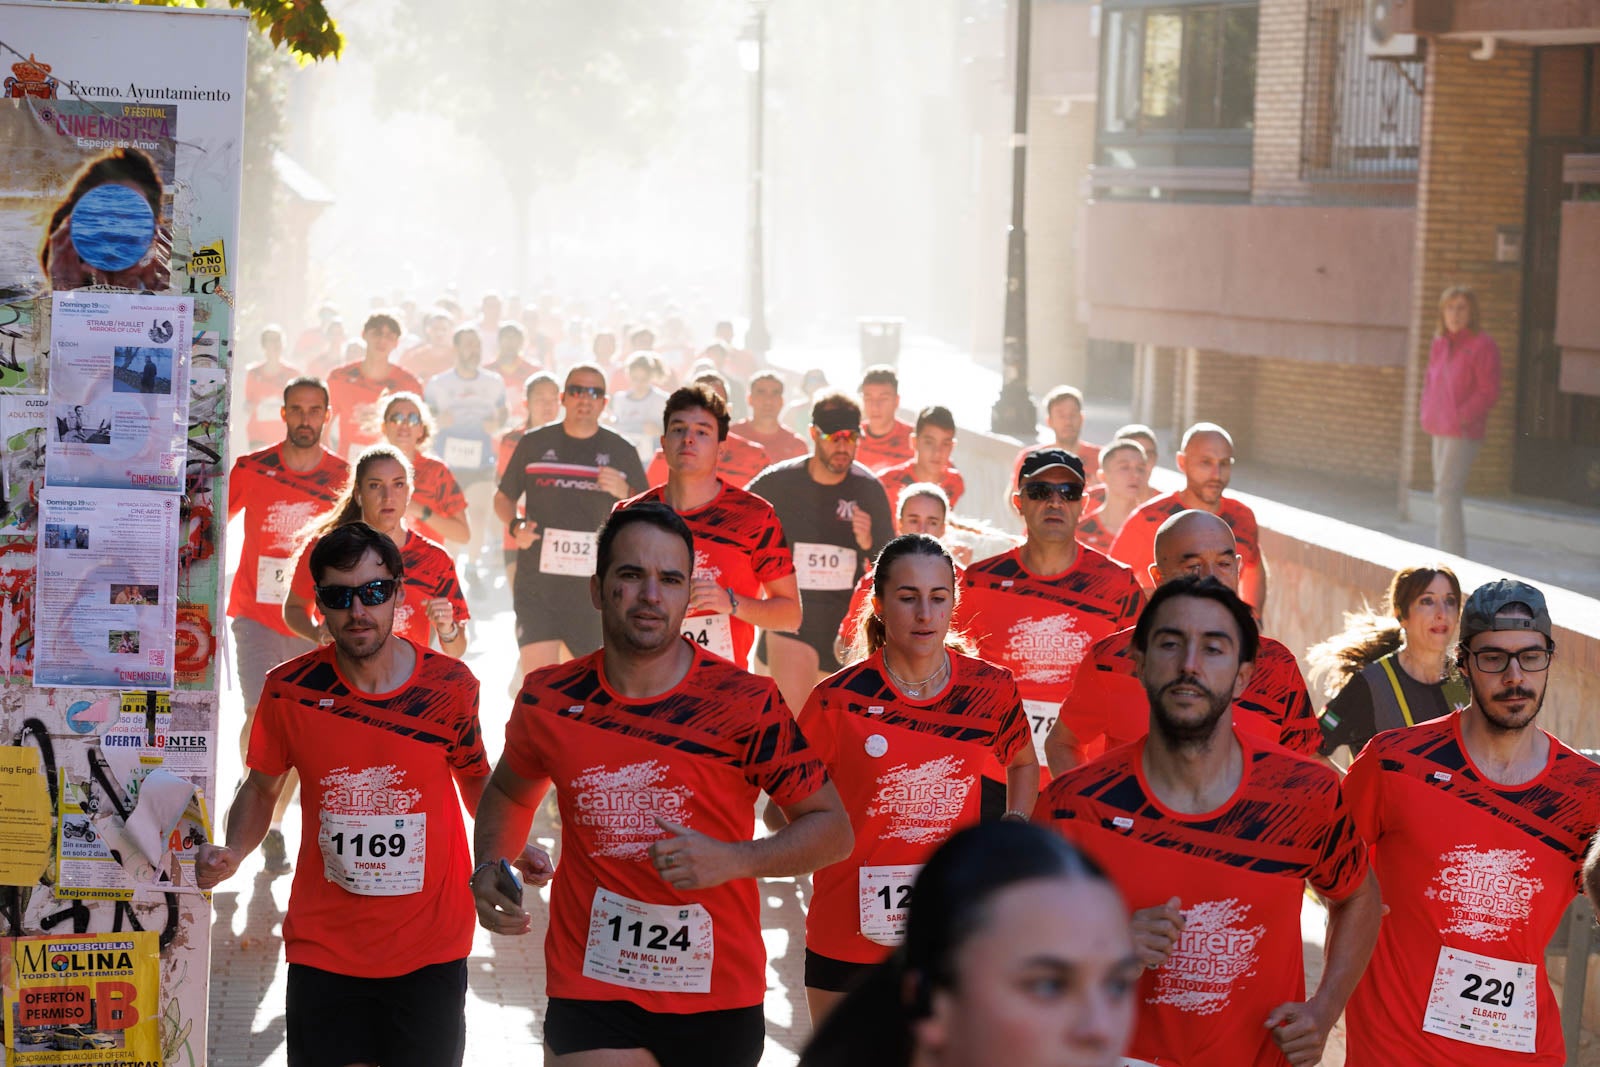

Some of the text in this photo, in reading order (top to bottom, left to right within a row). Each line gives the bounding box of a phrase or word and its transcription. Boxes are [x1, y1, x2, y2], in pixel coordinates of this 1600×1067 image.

[69, 80, 230, 102] Excmo. Ayuntamiento
[132, 107, 167, 118] FESTIVAL
[77, 138, 160, 150] Espejos de Amor
[206, 256, 221, 264] NO
[192, 265, 221, 274] VOTO
[60, 301, 90, 309] Domingo
[552, 540, 591, 555] 1032
[807, 553, 840, 568] 510
[1010, 634, 1083, 649] carrera
[133, 715, 143, 723] de
[105, 735, 142, 748] OFERTA
[879, 782, 968, 802] carrera
[324, 789, 412, 811] carrera
[577, 791, 681, 811] carrera
[879, 801, 964, 818] cruzroja.es
[906, 819, 926, 827] NOV
[930, 820, 952, 828] 2023
[331, 832, 406, 858] 1169
[611, 834, 636, 842] NOV
[354, 862, 386, 870] THOMAS
[1441, 867, 1533, 900] carrera
[59, 889, 122, 899] Mejoramos
[1439, 888, 1529, 917] cruzroja.es
[886, 914, 908, 922] SARA
[1453, 910, 1512, 927] 19 NOV 2023
[608, 915, 691, 951] 1124
[49, 942, 134, 952] AUTOESCUELAS
[22, 943, 133, 973] MOLINA
[620, 949, 677, 965] RVM MGL IVM
[1159, 978, 1171, 987] 19
[1177, 980, 1202, 991] NOV
[1460, 973, 1515, 1008] 229
[25, 988, 85, 1004] OFERTÓN
[26, 1007, 84, 1020] PERMISO
[95, 981, 140, 1031] B
[1472, 1007, 1507, 1021] ELBARTO
[62, 1053, 102, 1061] CUALQUIER
